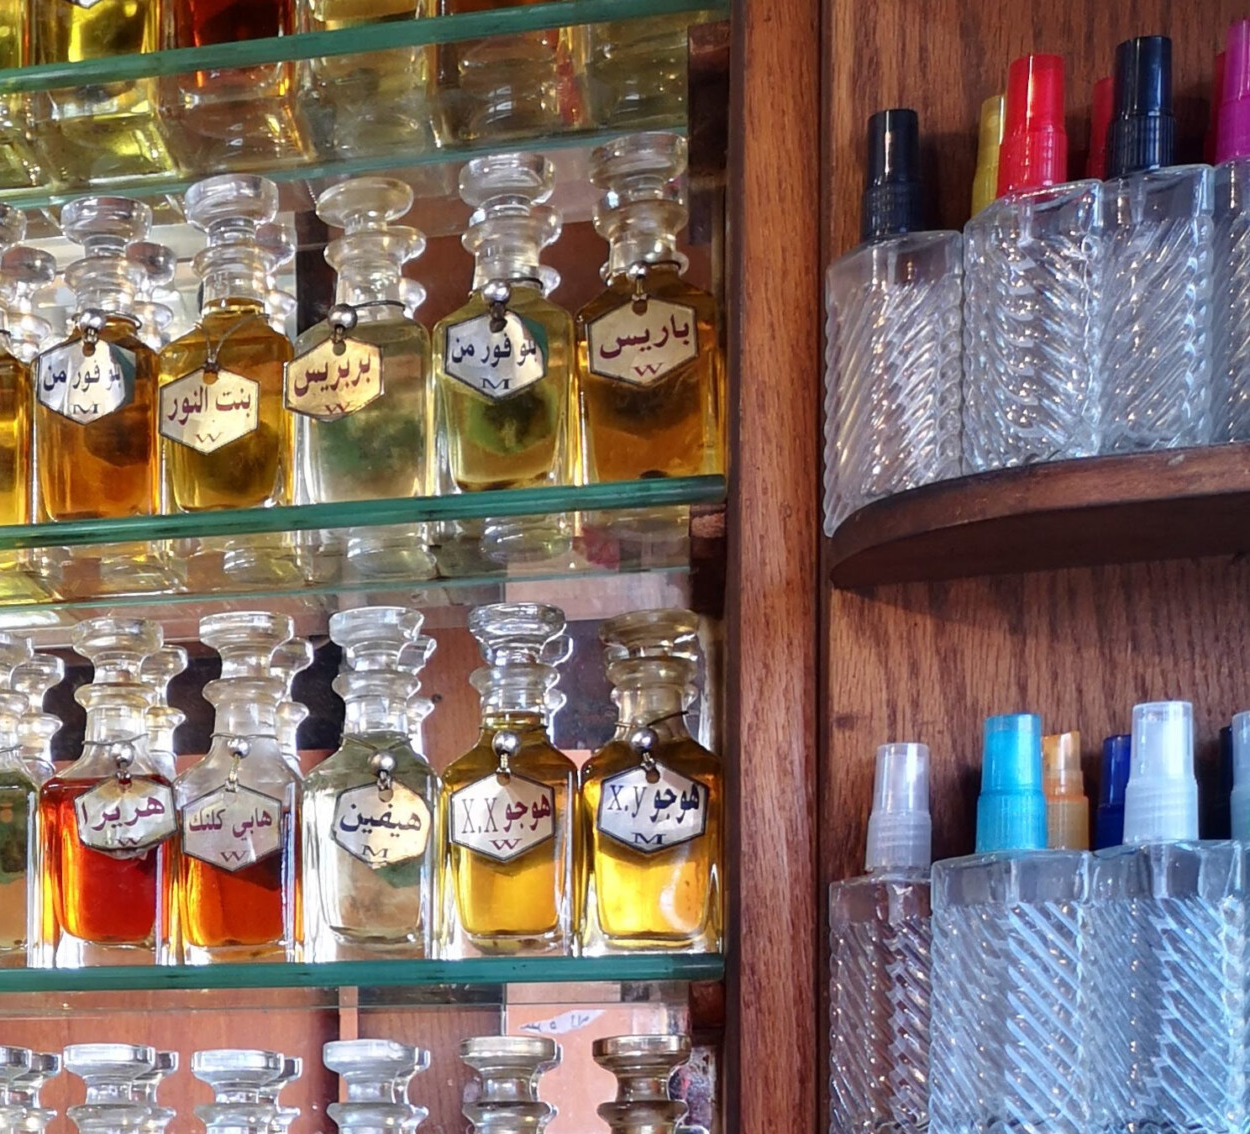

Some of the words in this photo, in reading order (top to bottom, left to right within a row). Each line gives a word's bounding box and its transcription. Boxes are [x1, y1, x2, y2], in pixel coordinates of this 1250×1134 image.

[452, 337, 475, 363] من
[481, 333, 511, 367] فور
[600, 315, 690, 359] باريس
[44, 361, 67, 391] من
[73, 360, 100, 393] فور
[293, 356, 371, 397] بربريس
[482, 378, 510, 390] M
[632, 363, 664, 377] W
[73, 404, 99, 415] M
[168, 386, 209, 424] النور
[215, 388, 252, 417] بنت
[325, 403, 350, 413] W
[196, 433, 223, 444] W
[82, 797, 166, 834] هريرا
[503, 794, 552, 833] هوجو
[649, 783, 700, 825] هوجو
[232, 808, 273, 839] هابي
[339, 803, 422, 838] هيفين
[117, 837, 142, 848] W
[361, 845, 389, 859] M
[488, 838, 523, 850] W
[631, 832, 667, 844] M
[220, 851, 248, 862] W
